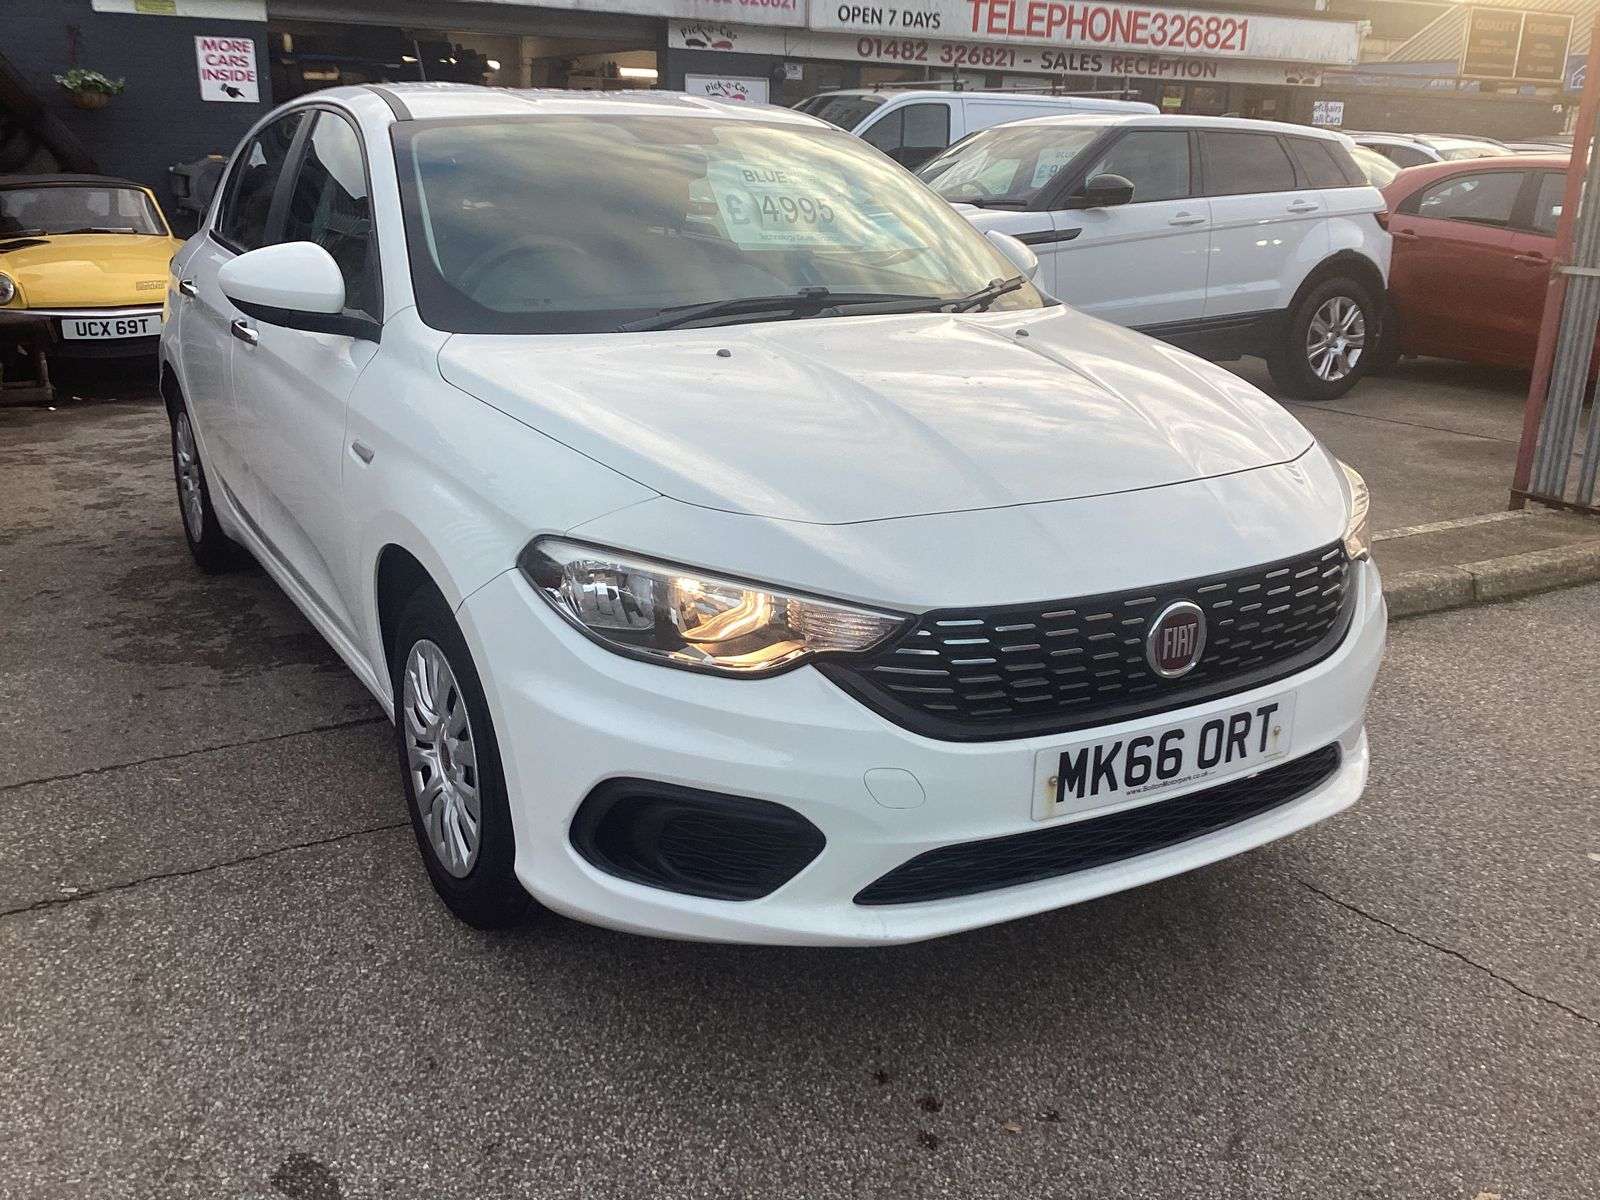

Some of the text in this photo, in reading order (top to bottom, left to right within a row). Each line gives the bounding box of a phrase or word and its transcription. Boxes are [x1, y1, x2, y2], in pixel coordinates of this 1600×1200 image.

[837, 5, 941, 29] OPEN 7 DAYS
[202, 40, 251, 54] MORE
[205, 53, 249, 68] CARS
[857, 37, 929, 62] 01482
[940, 44, 1016, 67] 326821
[1040, 51, 1103, 73] SALES
[1111, 57, 1218, 79] RECEPTION
[202, 68, 256, 82] INSIDE
[76, 319, 149, 337] UCX 69T
[1162, 622, 1198, 660] FIAT
[1056, 703, 1279, 803] MK66 ORT
